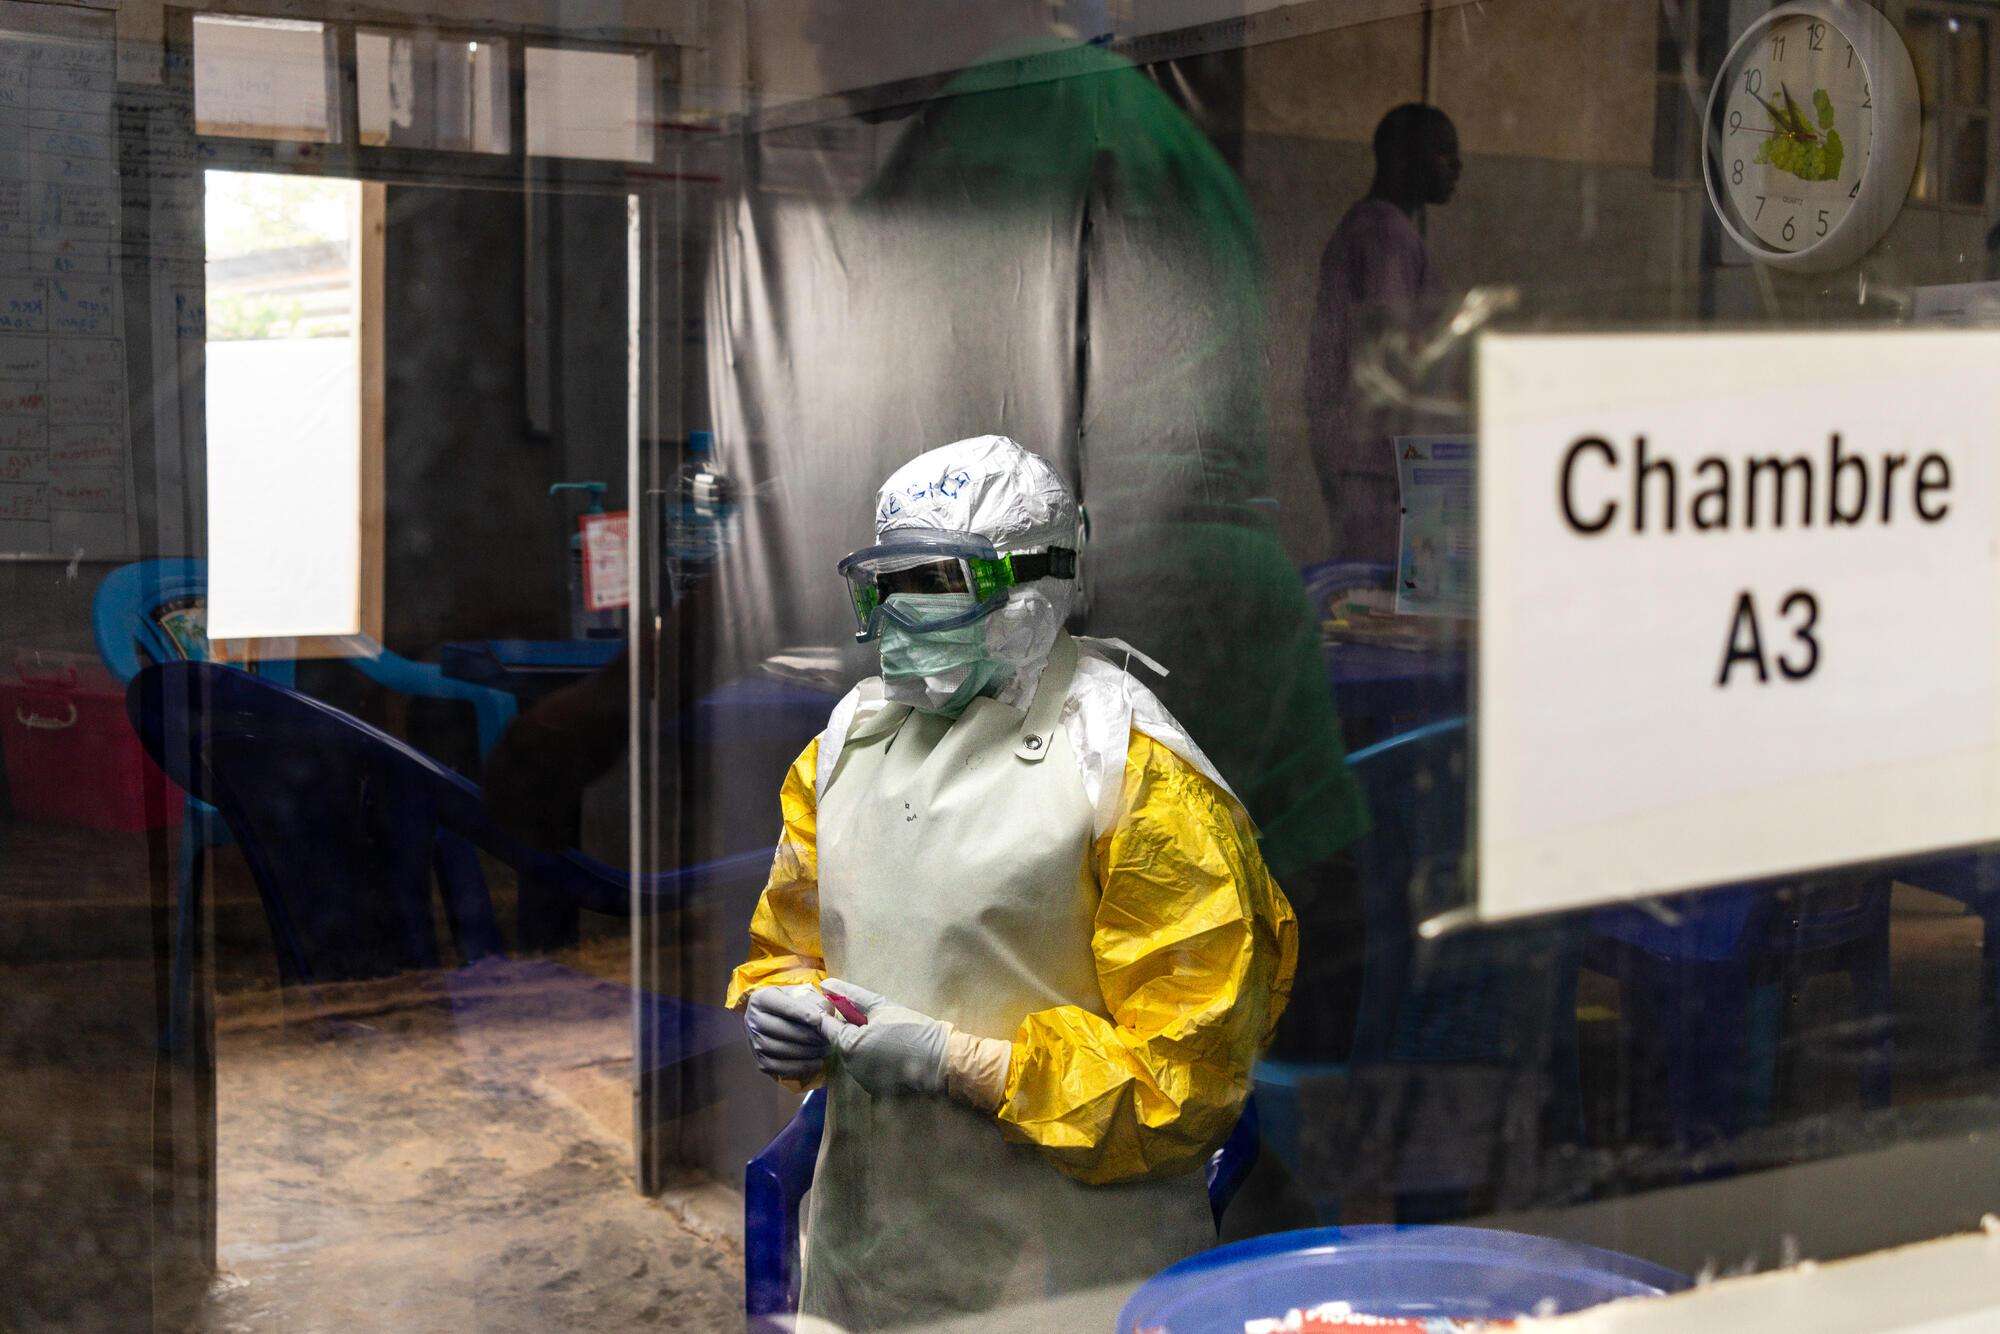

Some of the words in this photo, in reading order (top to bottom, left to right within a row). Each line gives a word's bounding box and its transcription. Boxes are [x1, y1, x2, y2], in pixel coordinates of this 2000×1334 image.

[1771, 36, 1786, 62] 11
[1807, 24, 1826, 51] 12
[1846, 44, 1854, 69] 1
[1744, 69, 1762, 95] 10
[1729, 110, 1743, 136] 9
[1732, 159, 1744, 185] 8
[1755, 196, 1766, 221] 7
[1782, 216, 1795, 242] 6
[1816, 210, 1829, 237] 5
[1558, 432, 1953, 538] Chambre
[1714, 588, 1824, 688] A3
